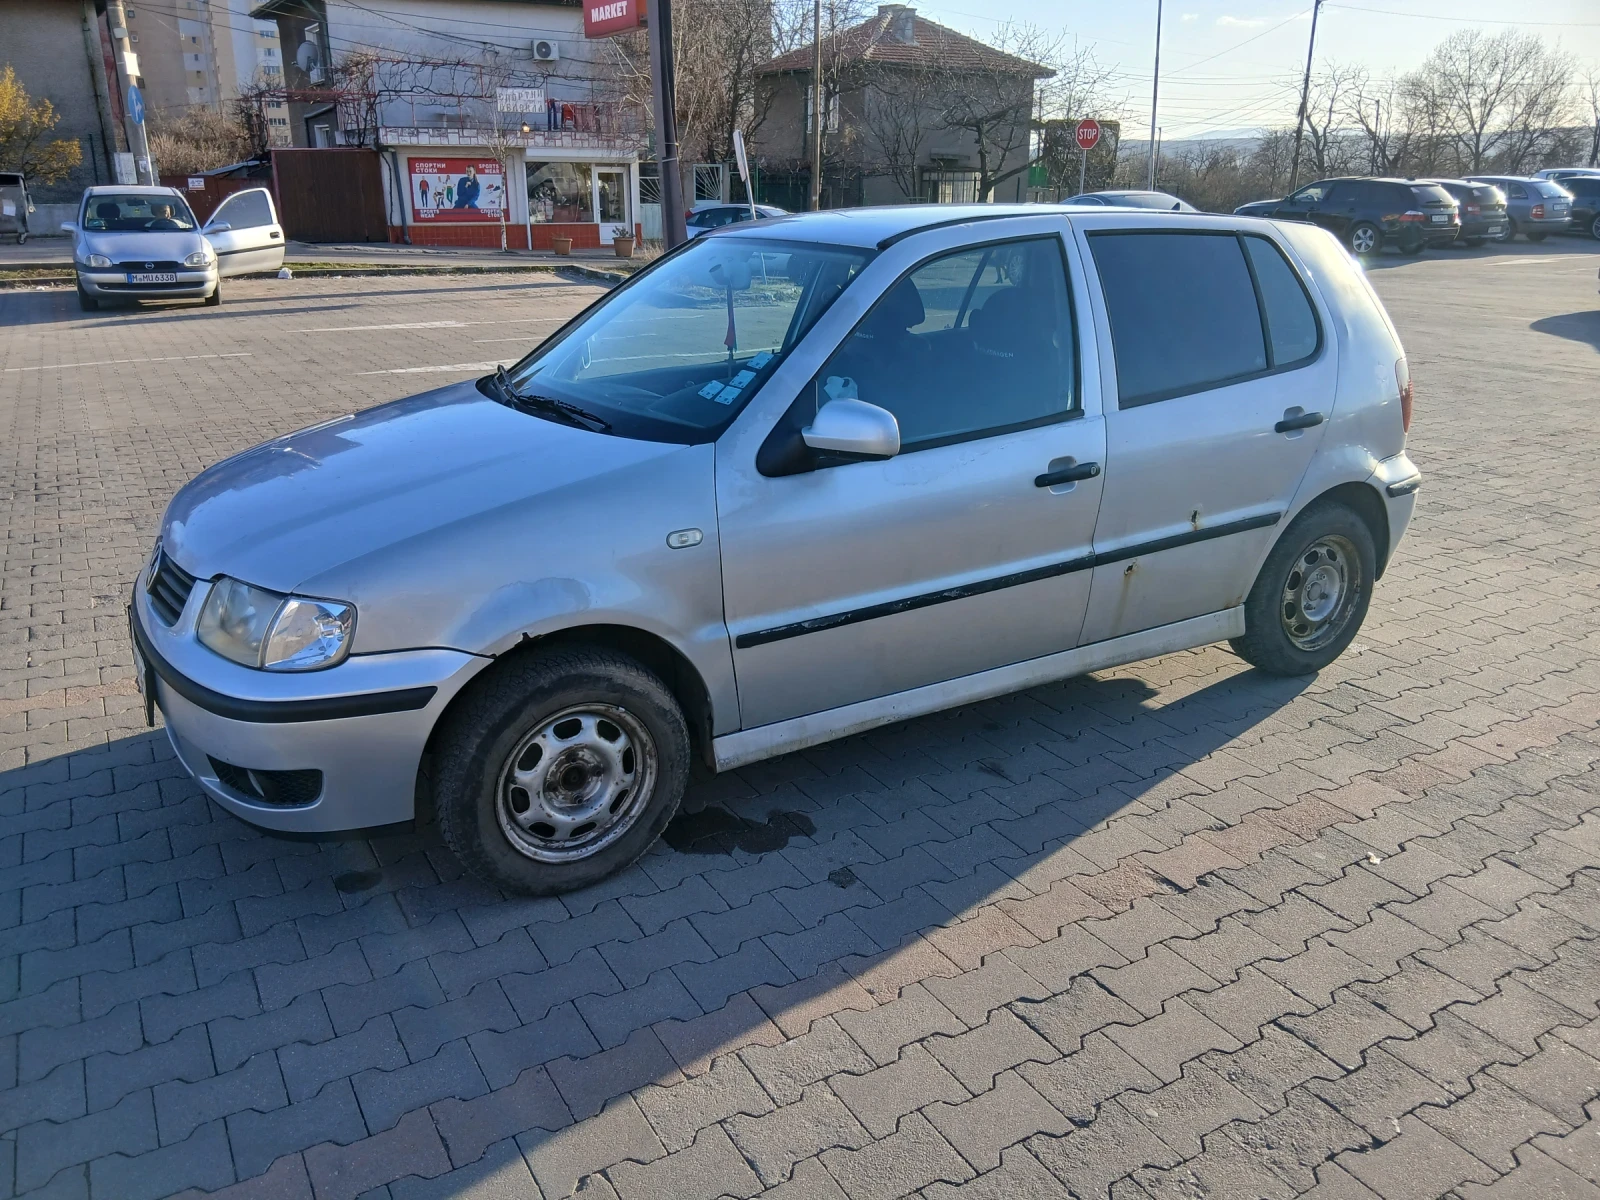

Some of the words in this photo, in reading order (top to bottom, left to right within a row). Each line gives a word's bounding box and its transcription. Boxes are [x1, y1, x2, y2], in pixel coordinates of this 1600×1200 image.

[591, 1, 627, 23] MARKET
[1079, 129, 1097, 139] STOP
[155, 274, 175, 282] 6338
